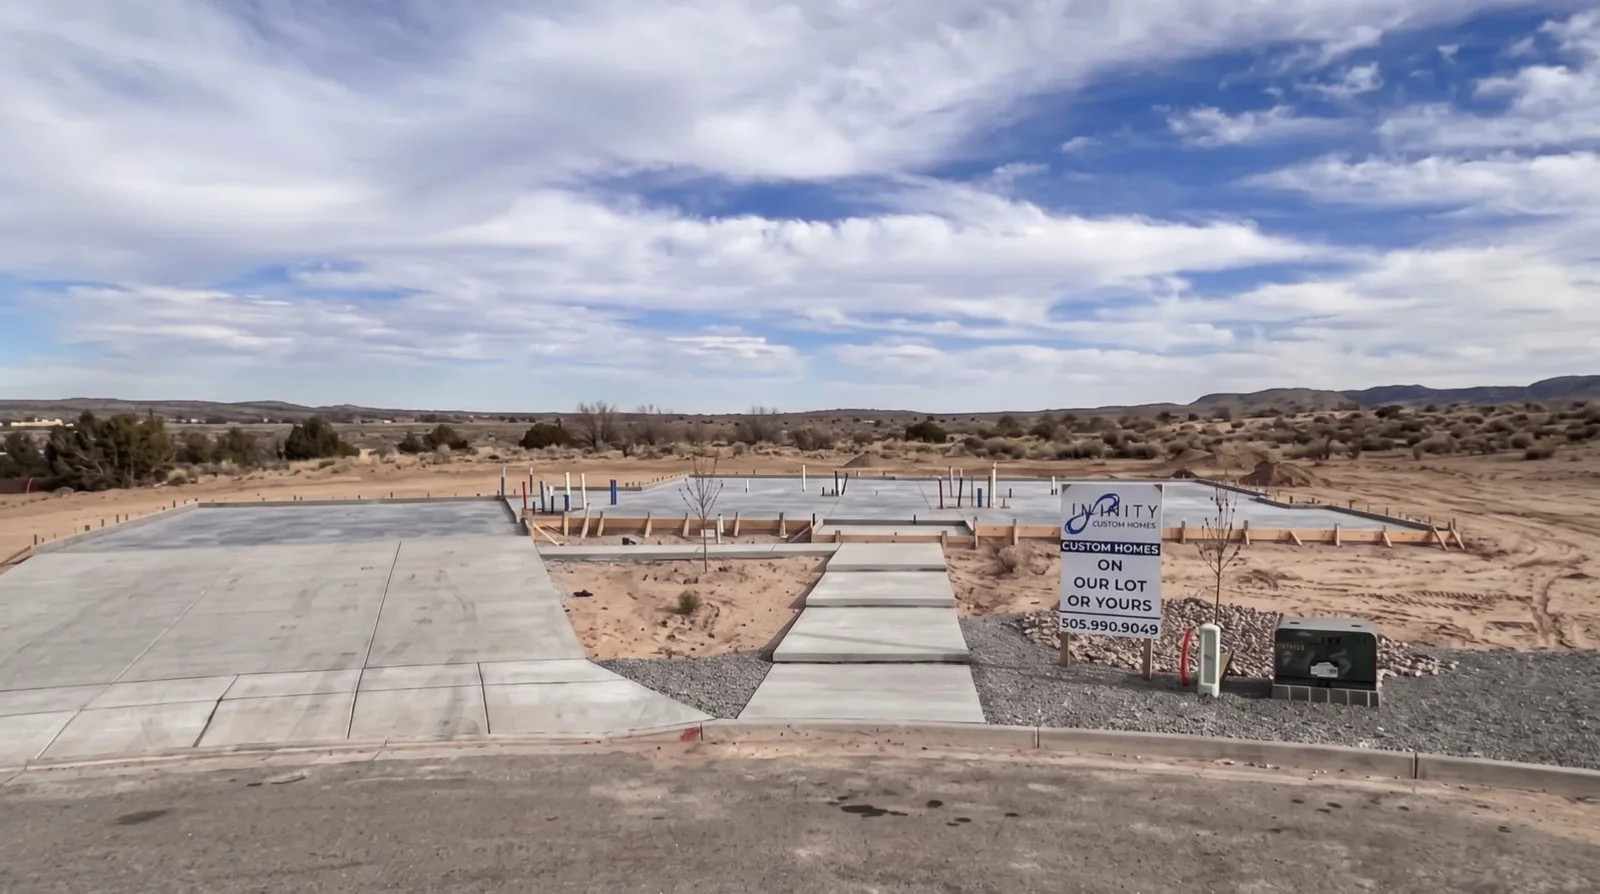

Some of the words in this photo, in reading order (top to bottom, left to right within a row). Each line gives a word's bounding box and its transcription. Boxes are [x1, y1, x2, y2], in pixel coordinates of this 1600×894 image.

[1062, 541, 1111, 552] CUSTOM
[1114, 543, 1159, 554] HOMES
[1097, 559, 1122, 571] ON
[1073, 576, 1109, 590] OUR
[1115, 579, 1147, 592] LOT
[1067, 595, 1091, 608] OR
[1095, 596, 1152, 612] YOURS
[1061, 618, 1158, 635] 505.990.9049
